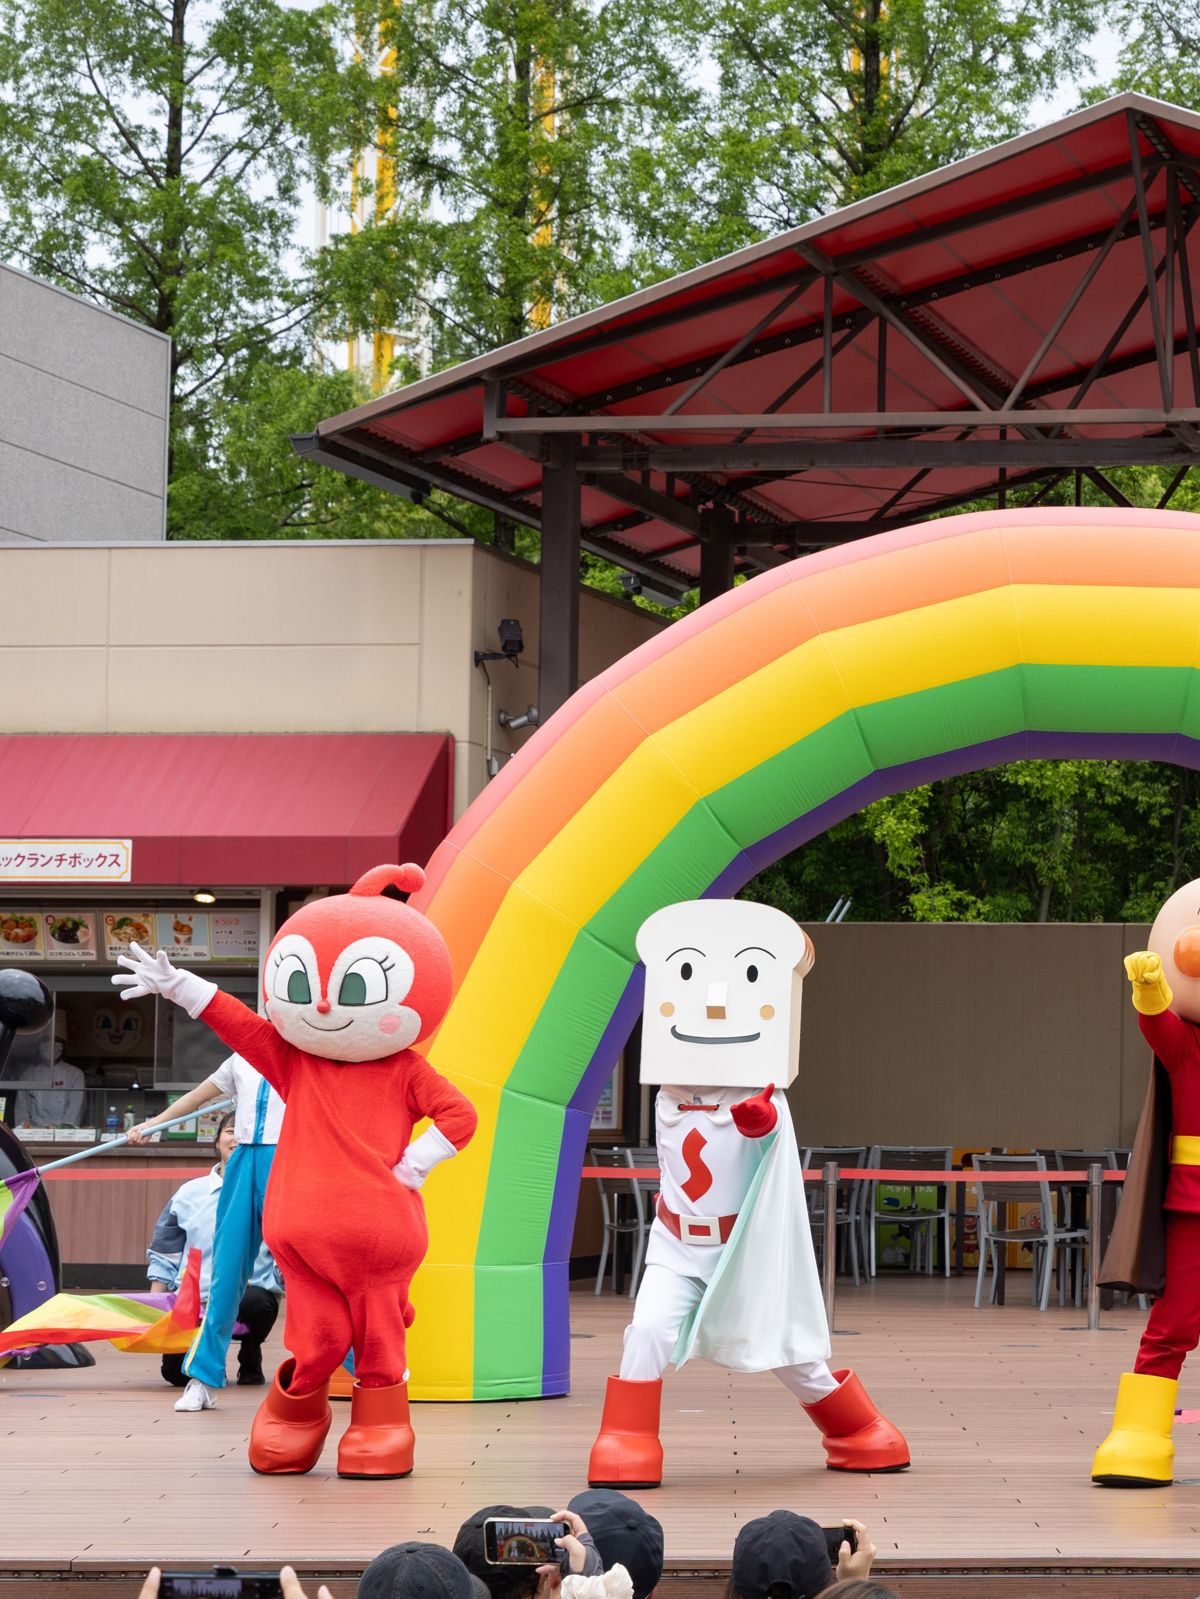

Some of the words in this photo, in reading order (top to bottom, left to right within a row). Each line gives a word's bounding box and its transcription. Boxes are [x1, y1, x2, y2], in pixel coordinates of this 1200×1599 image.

[0, 852, 121, 868] ックランチボックス
[680, 1127, 713, 1203] S
